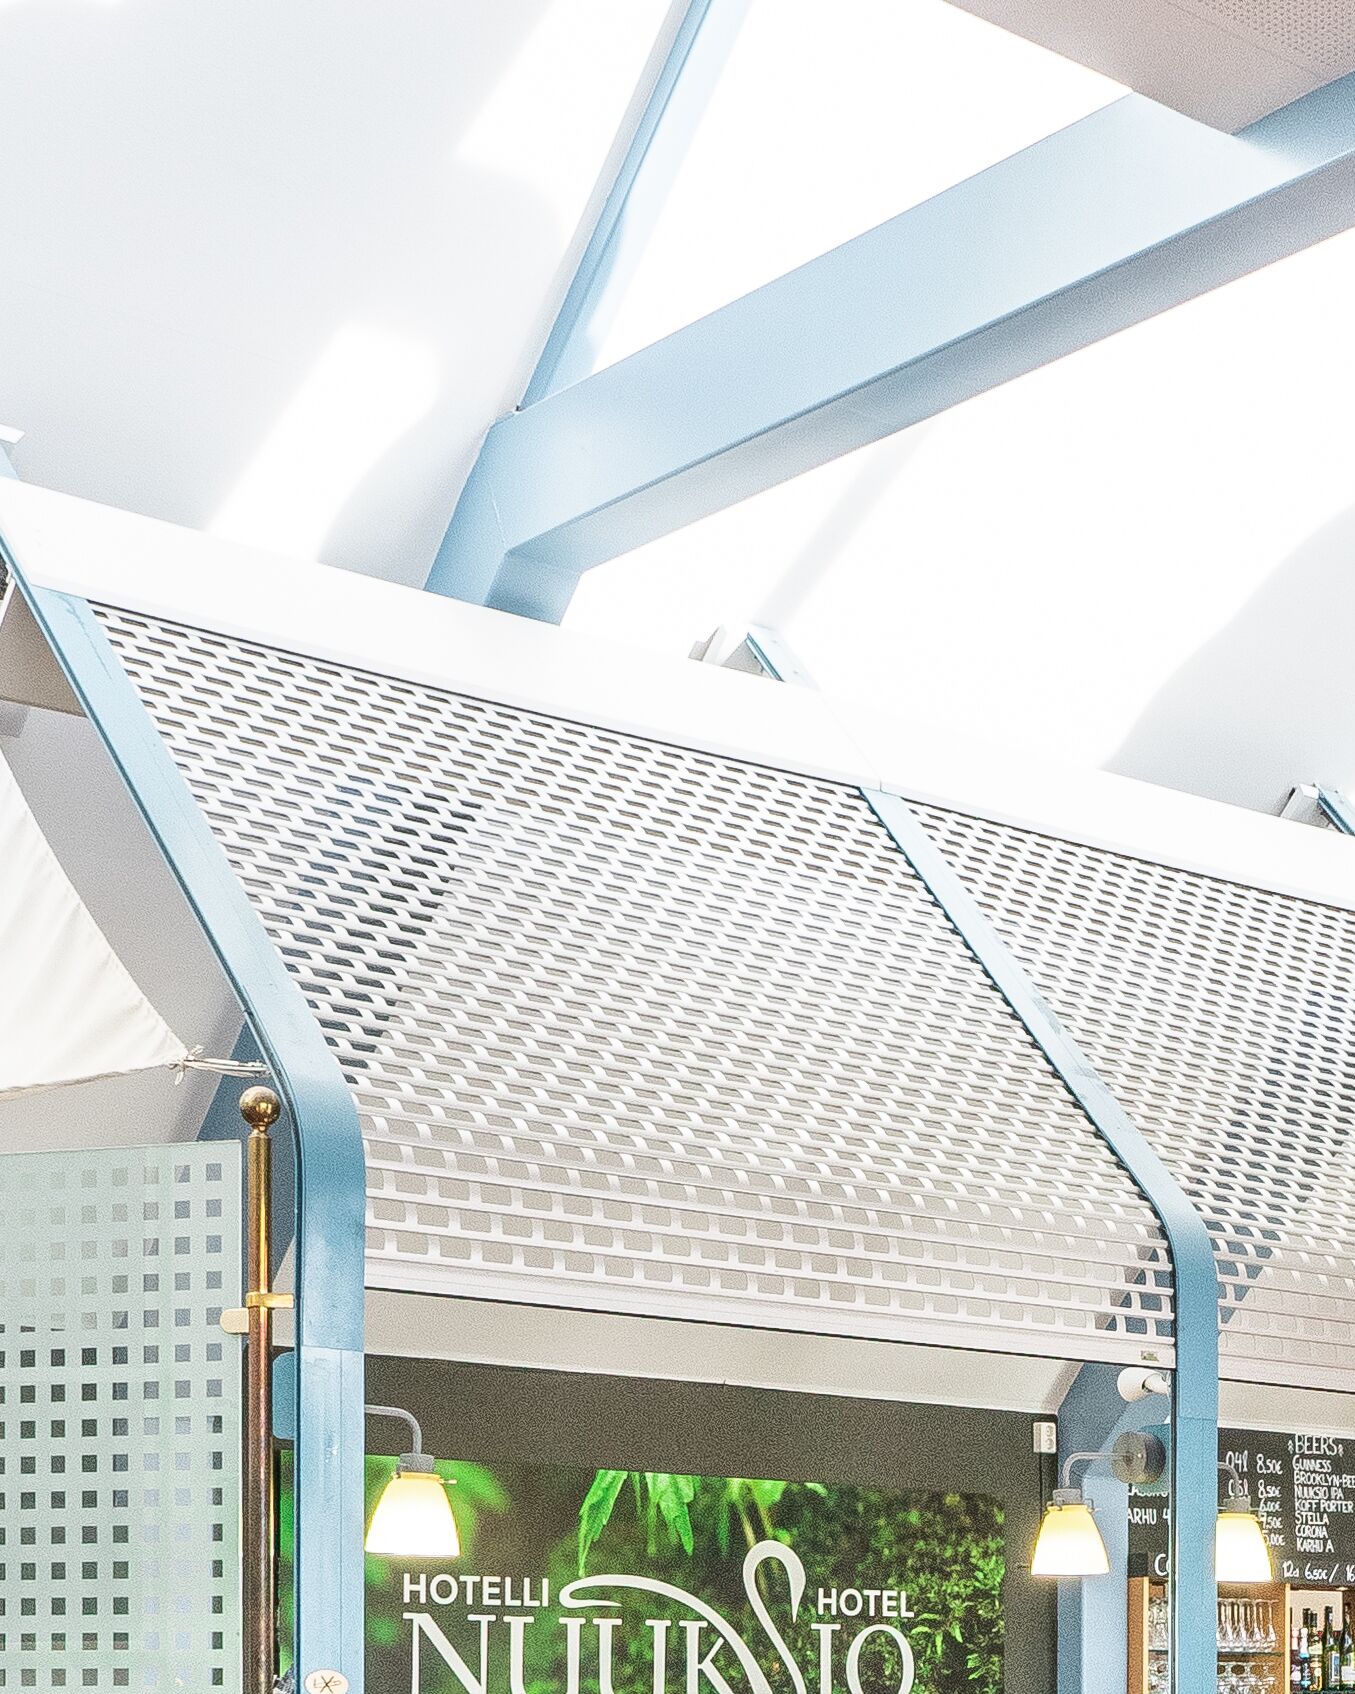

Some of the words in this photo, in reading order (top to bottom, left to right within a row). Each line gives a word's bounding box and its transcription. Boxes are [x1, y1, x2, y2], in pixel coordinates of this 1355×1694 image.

[1295, 1435, 1337, 1455] BEERS
[1292, 1454, 1332, 1472] GUINNESS
[1331, 1486, 1344, 1500] IPA
[1295, 1498, 1319, 1512] KOFF
[1320, 1500, 1354, 1513] PORTER
[1128, 1508, 1157, 1526] ARHU
[1295, 1511, 1329, 1525] STELLA
[1296, 1525, 1328, 1539] CORONA
[1296, 1537, 1323, 1553] KARHU
[1325, 1540, 1335, 1553] A
[402, 1573, 549, 1608] HOTELLI
[817, 1587, 915, 1618] HOTEL
